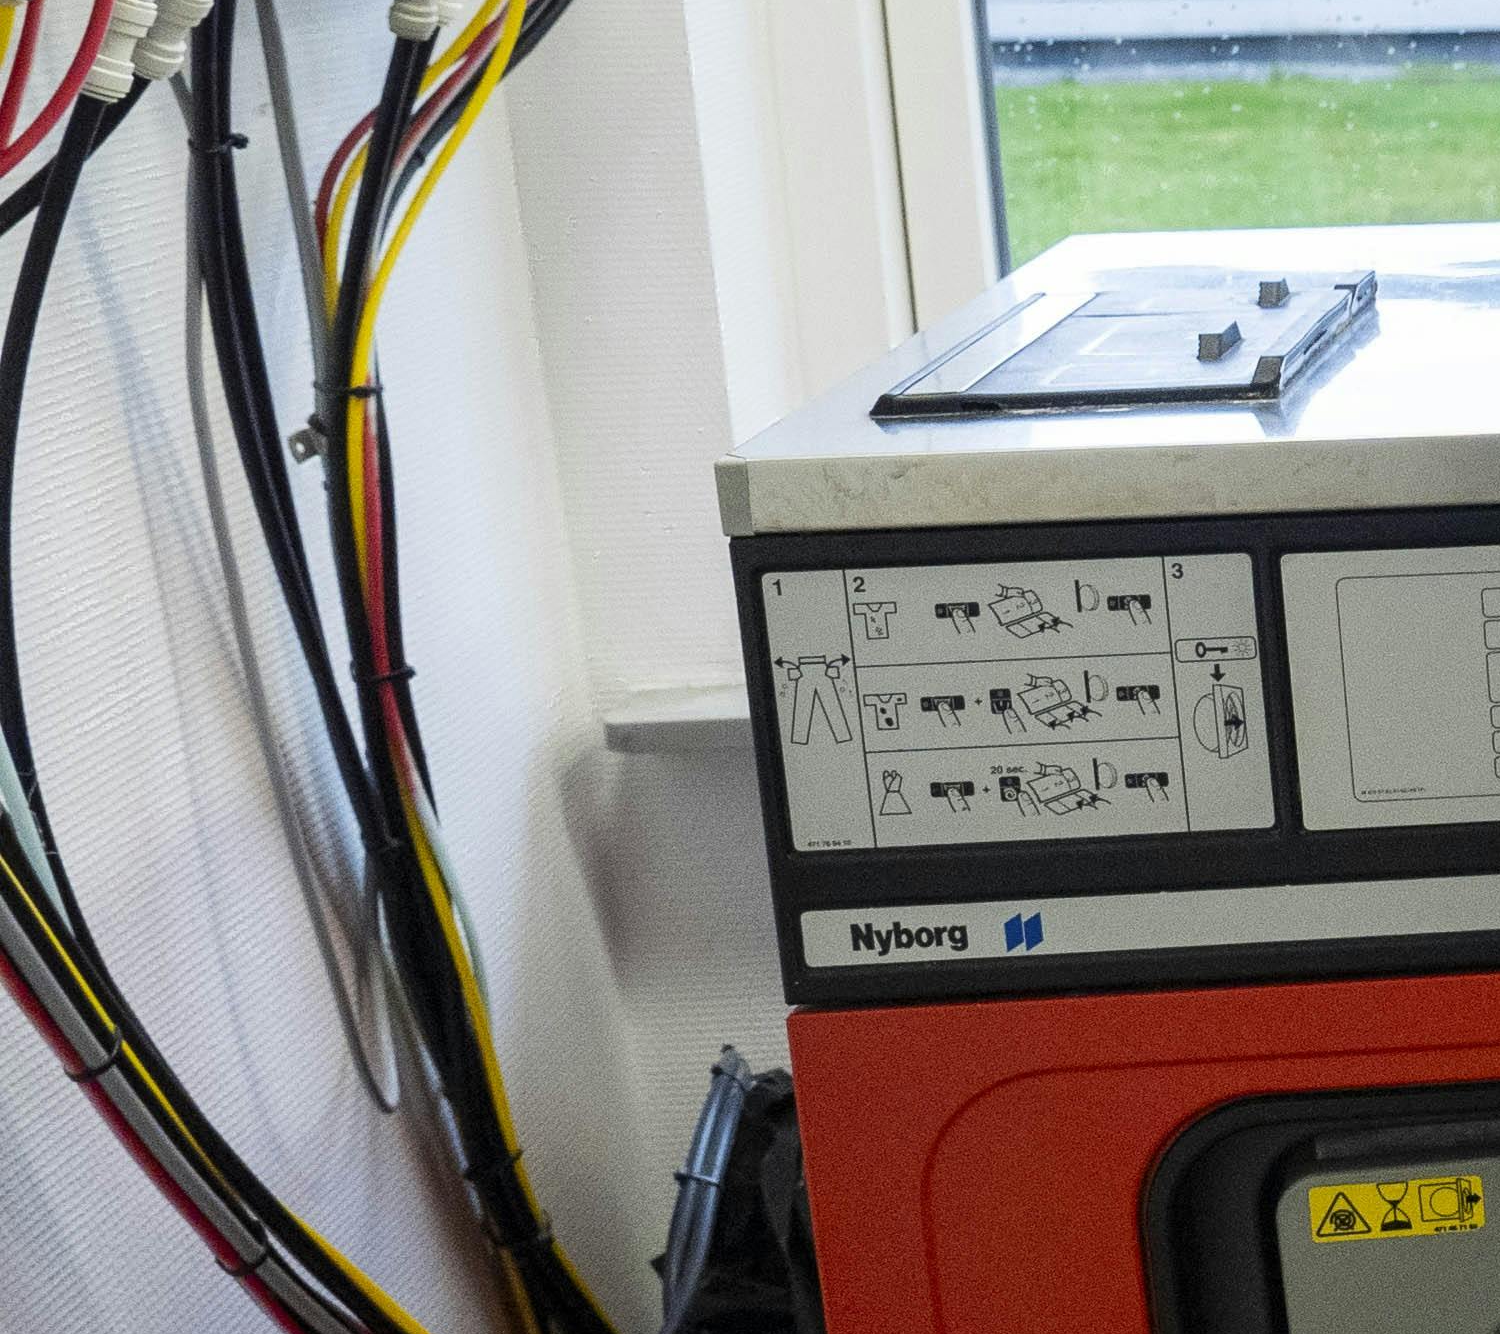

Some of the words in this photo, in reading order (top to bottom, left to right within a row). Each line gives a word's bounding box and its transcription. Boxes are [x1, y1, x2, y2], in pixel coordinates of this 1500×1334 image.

[1171, 563, 1183, 579] 3
[773, 579, 783, 596] 1
[853, 577, 865, 593] 2
[990, 765, 1003, 775] 20
[850, 921, 969, 957] Nyborg
